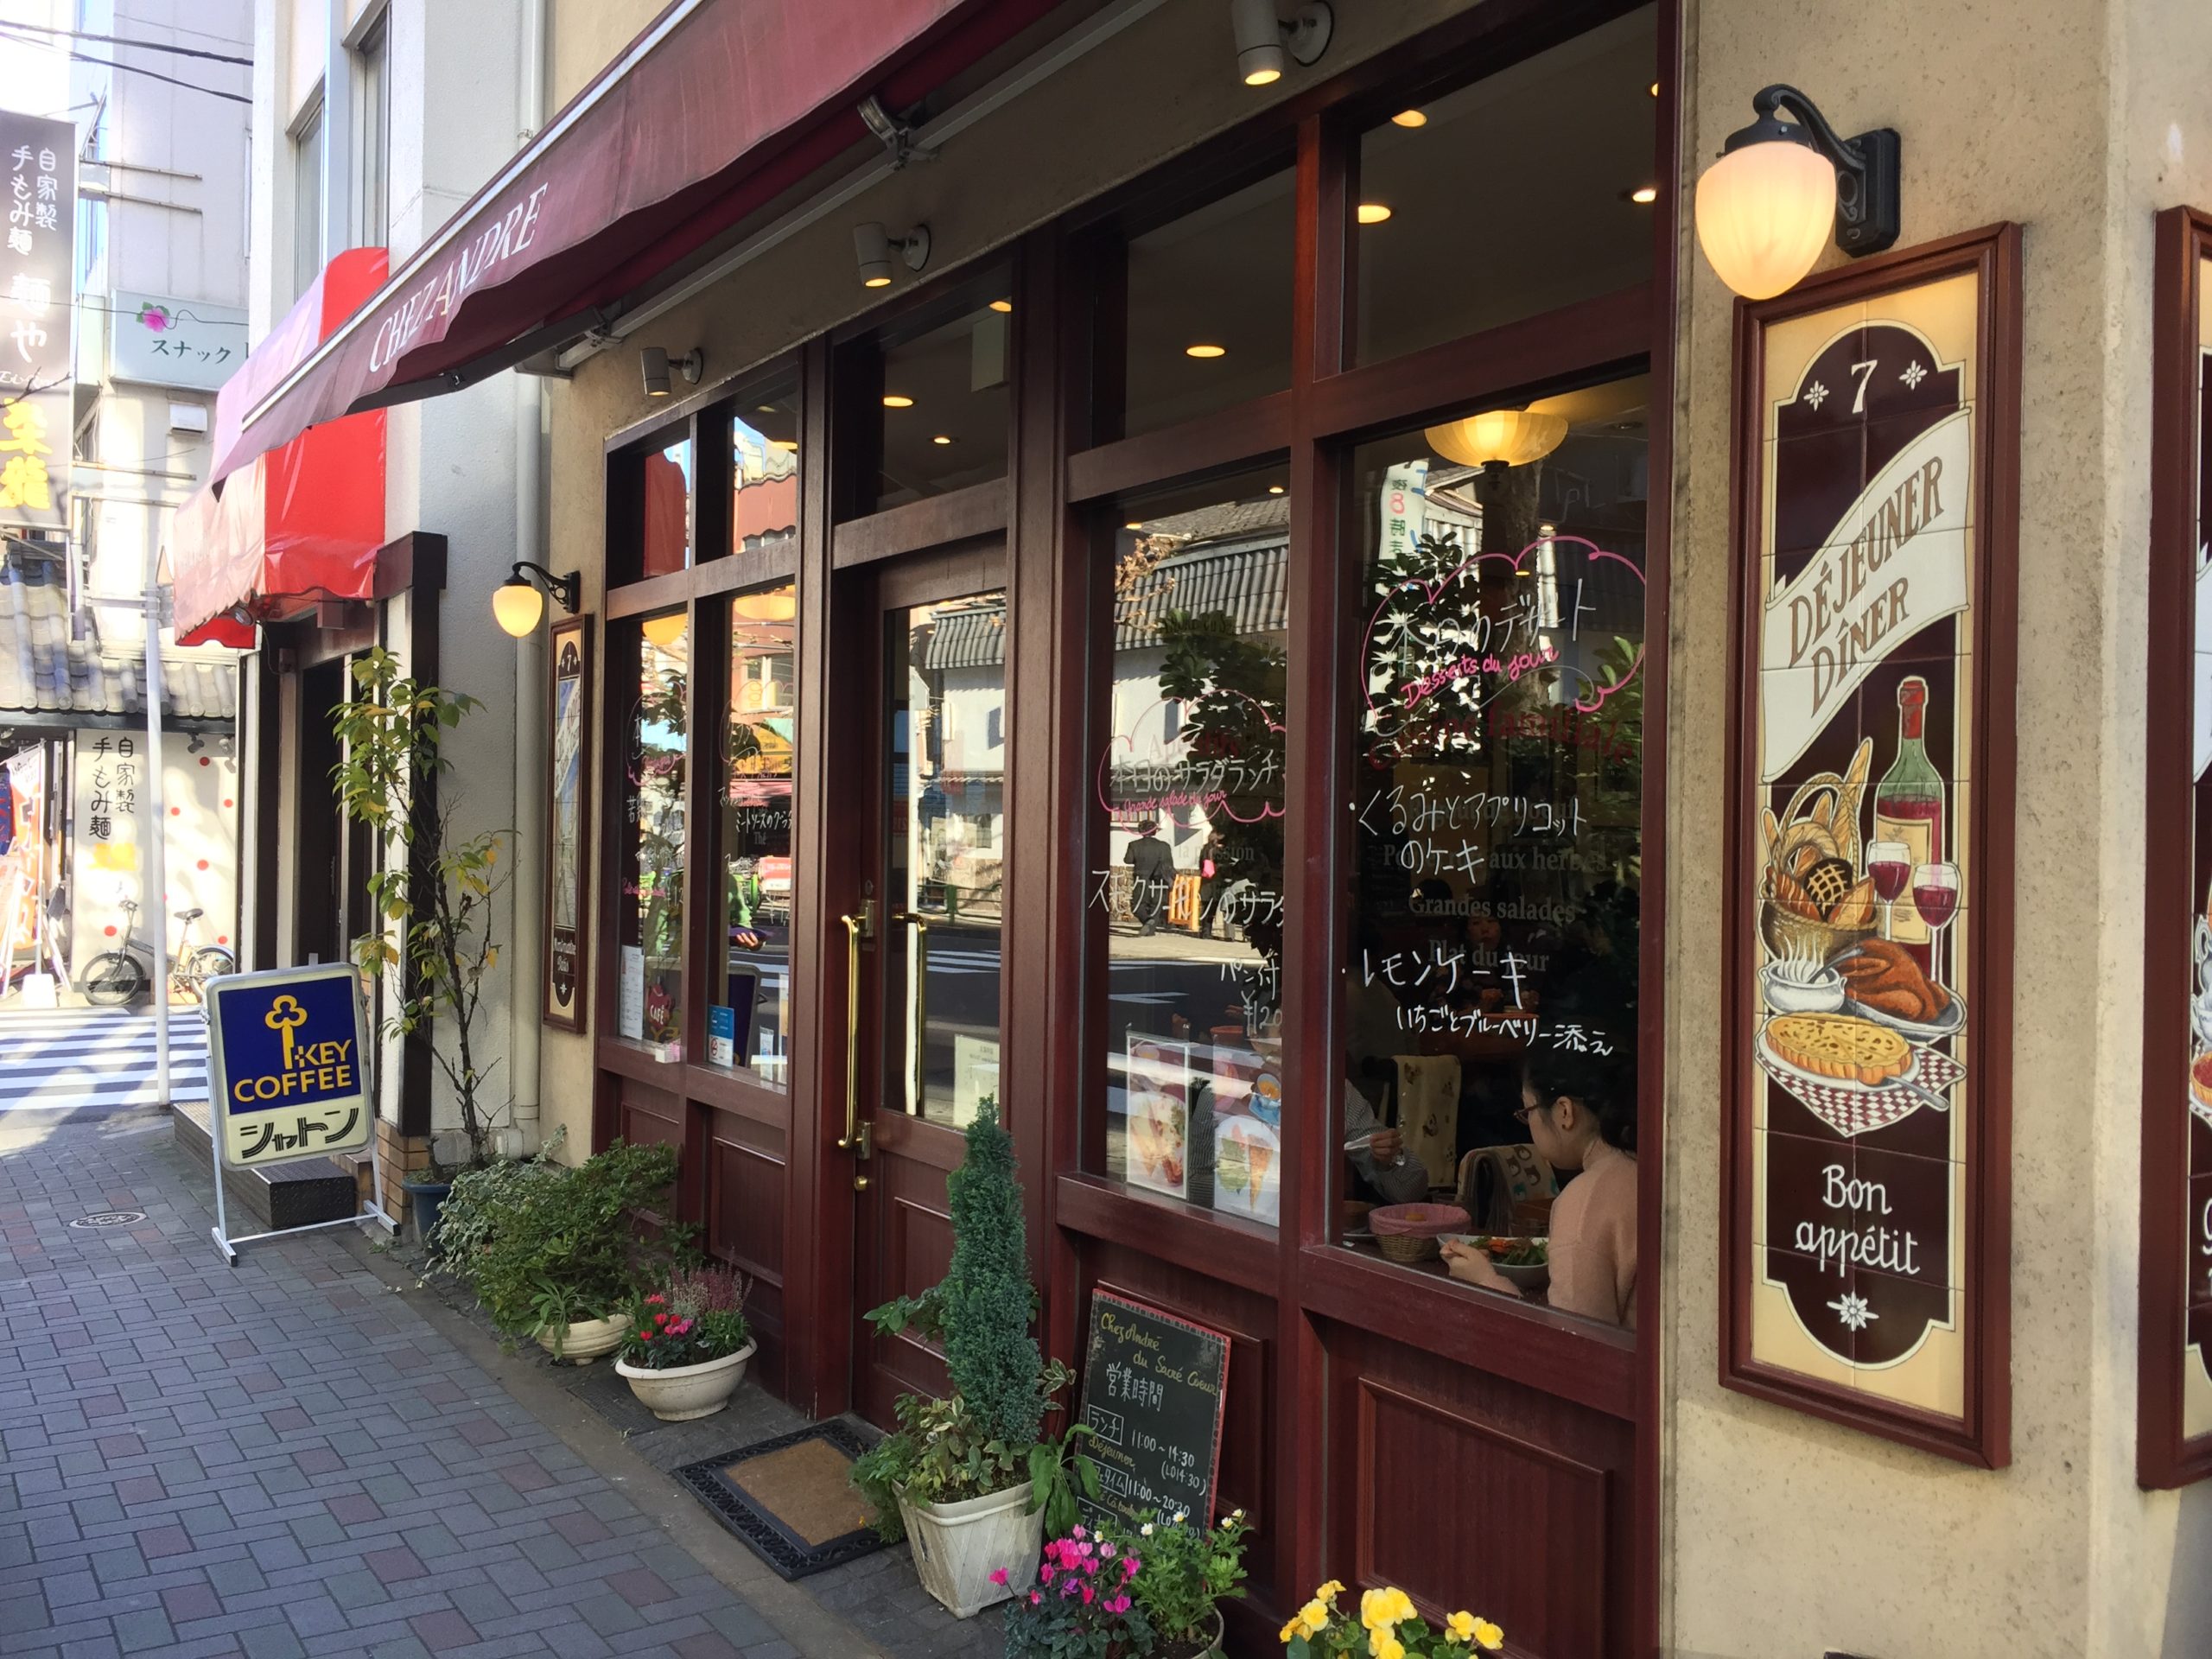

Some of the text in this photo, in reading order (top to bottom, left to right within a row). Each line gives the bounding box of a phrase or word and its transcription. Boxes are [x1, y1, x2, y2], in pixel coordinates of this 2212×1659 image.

[7, 144, 35, 257] 手もみ麺
[35, 147, 59, 232] 自家製
[369, 181, 549, 373] CHEZ ANDRE
[151, 339, 232, 365] スナック
[1850, 359, 1878, 415] 7
[1788, 454, 1945, 670] DÉJEUNER
[1810, 576, 1910, 720] DÎNER
[1400, 645, 1560, 709] Desserts du jour
[89, 737, 113, 840] 手もみ麺
[116, 737, 135, 814] 自家製
[1401, 837, 1485, 885] のケーキ
[1363, 947, 1529, 1010] レモンケーキ
[295, 1039, 353, 1068] KEY
[233, 1064, 353, 1103] COFFEE
[239, 1107, 359, 1160] シャトン
[1821, 1163, 1893, 1216] Bon
[1794, 1219, 1921, 1278] appétit
[1106, 1361, 1165, 1413] 営業時間
[1133, 1350, 1148, 1370] du
[1090, 1409, 1121, 1440] ランチ
